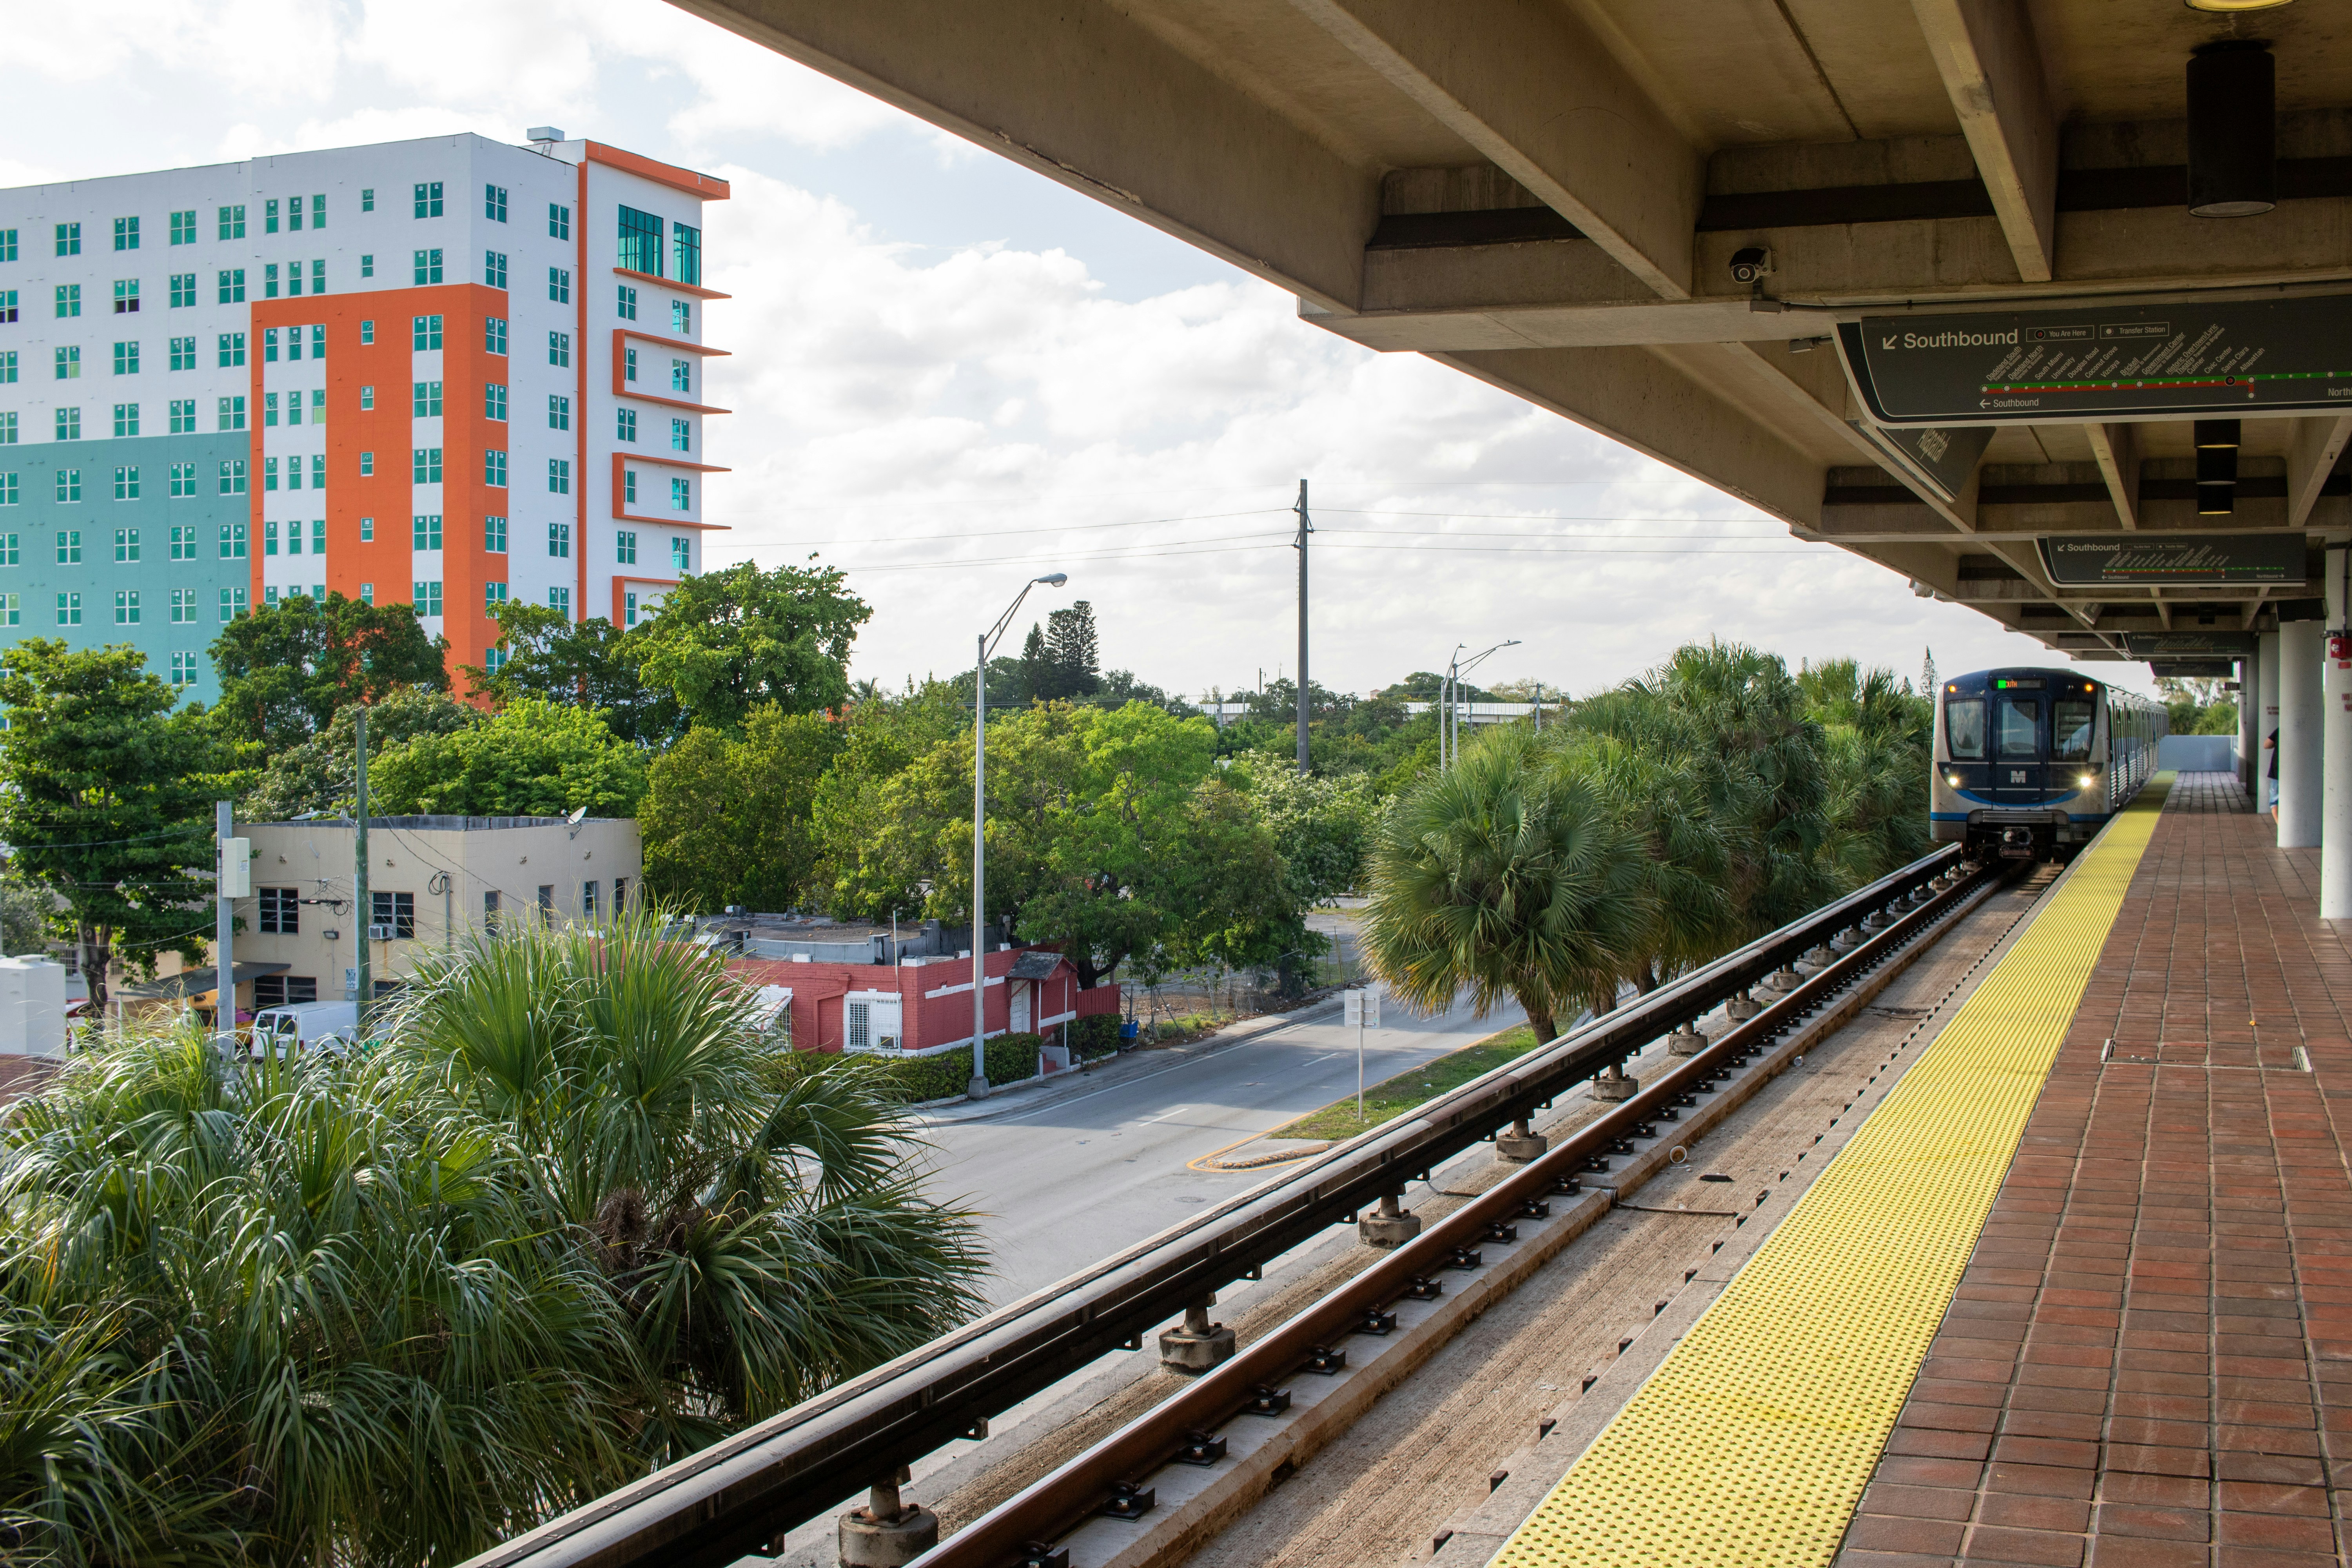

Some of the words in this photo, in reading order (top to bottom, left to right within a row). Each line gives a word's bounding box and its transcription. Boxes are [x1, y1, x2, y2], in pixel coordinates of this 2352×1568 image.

[1904, 329, 2018, 348] Southbound
[2165, 357, 2184, 375] Historic
[2183, 324, 2218, 358] Overtown/Lyric
[2176, 357, 2194, 374] Theatre
[2193, 345, 2207, 358] Transfer
[2209, 327, 2225, 343] Brightline
[1986, 358, 2007, 380] Dadeland
[2007, 346, 2022, 360] South
[2008, 358, 2030, 379] Dadeland
[2028, 345, 2043, 359] North
[2035, 366, 2050, 379] South
[2048, 351, 2063, 367] Miami
[2067, 359, 2087, 378] Douglas
[2085, 347, 2099, 360] Road
[2085, 359, 2105, 378] Coconut
[2103, 346, 2118, 360] Grove
[2120, 357, 2139, 376] Brickell
[2127, 364, 2140, 376] Transfer
[2143, 343, 2161, 361] Metromover
[2142, 347, 2171, 375] Government
[2168, 332, 2185, 348] Center
[2149, 363, 2162, 376] Transfer
[2165, 342, 2183, 360] Metromover
[2187, 357, 2205, 374] Culmer
[2204, 362, 2217, 374] Civic
[2215, 347, 2232, 362] Center
[2221, 359, 2237, 373] Santa
[2235, 347, 2249, 359] Clara
[2240, 348, 2265, 372] Allapattah
[1994, 369, 2006, 381] Transfer
[2009, 354, 2022, 367] Busway
[2015, 368, 2028, 381] Transfer
[2030, 354, 2043, 366] Busway
[2051, 357, 2075, 379] University
[2101, 360, 2120, 377] Vizcaya
[1993, 398, 2038, 407] Southbound
[2067, 543, 2120, 552] Southbound
